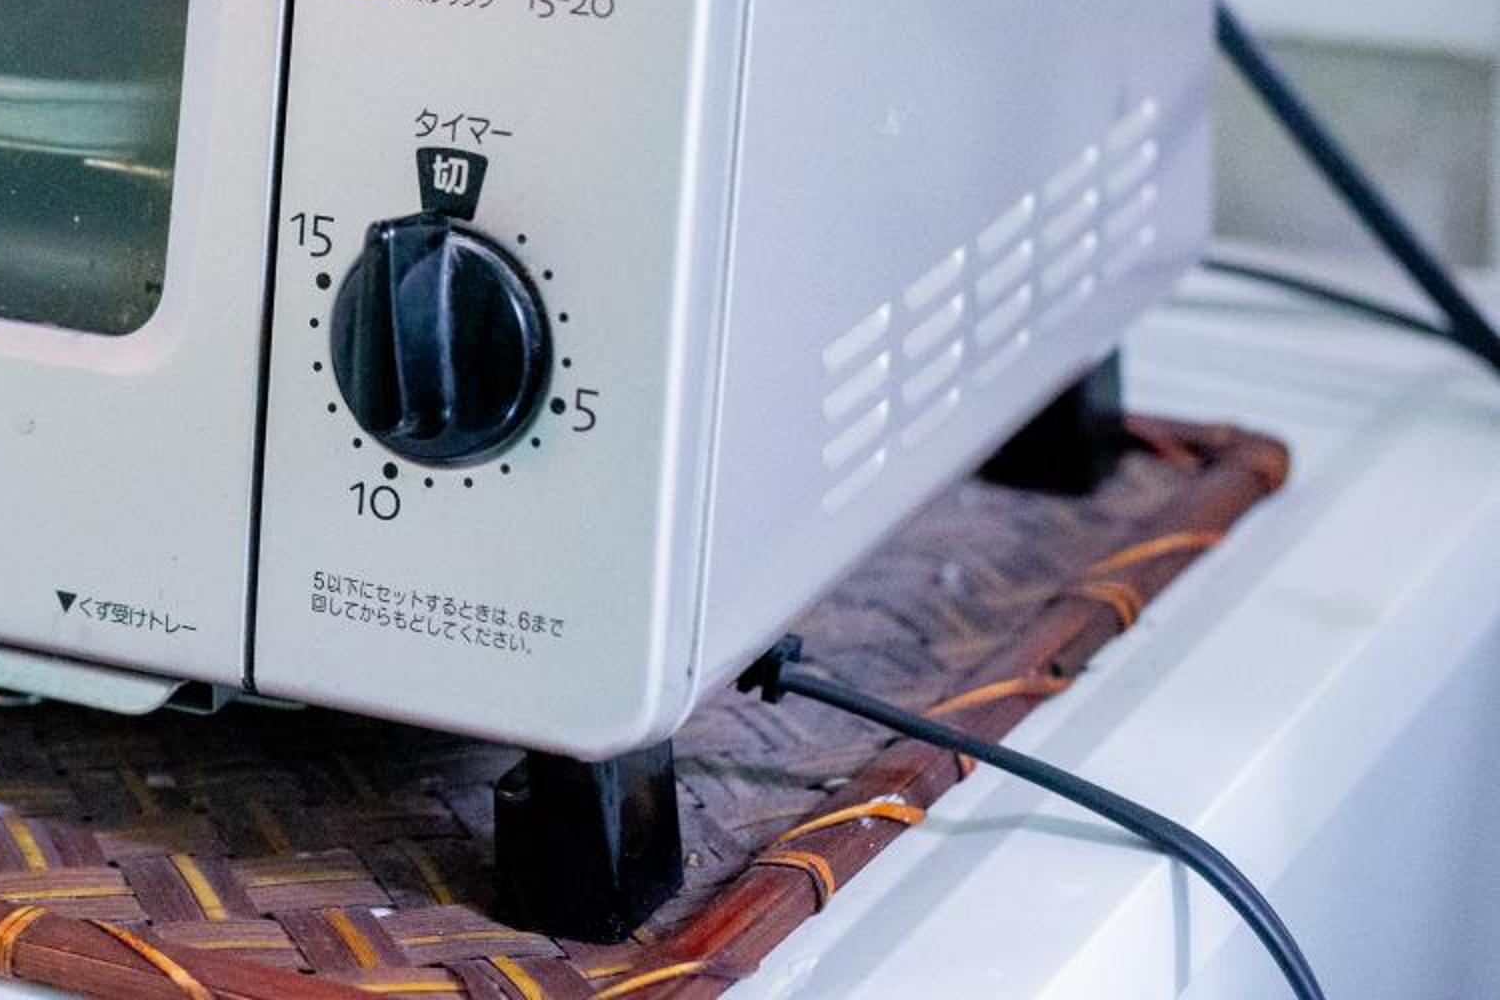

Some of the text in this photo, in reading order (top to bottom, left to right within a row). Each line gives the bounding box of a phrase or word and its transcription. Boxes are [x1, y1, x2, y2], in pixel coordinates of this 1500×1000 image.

[414, 107, 513, 144] タイマー
[432, 153, 470, 195] 切
[290, 212, 335, 257] 15
[571, 388, 599, 432] 5
[349, 481, 401, 520] 10
[79, 597, 197, 633] くず受けトレー
